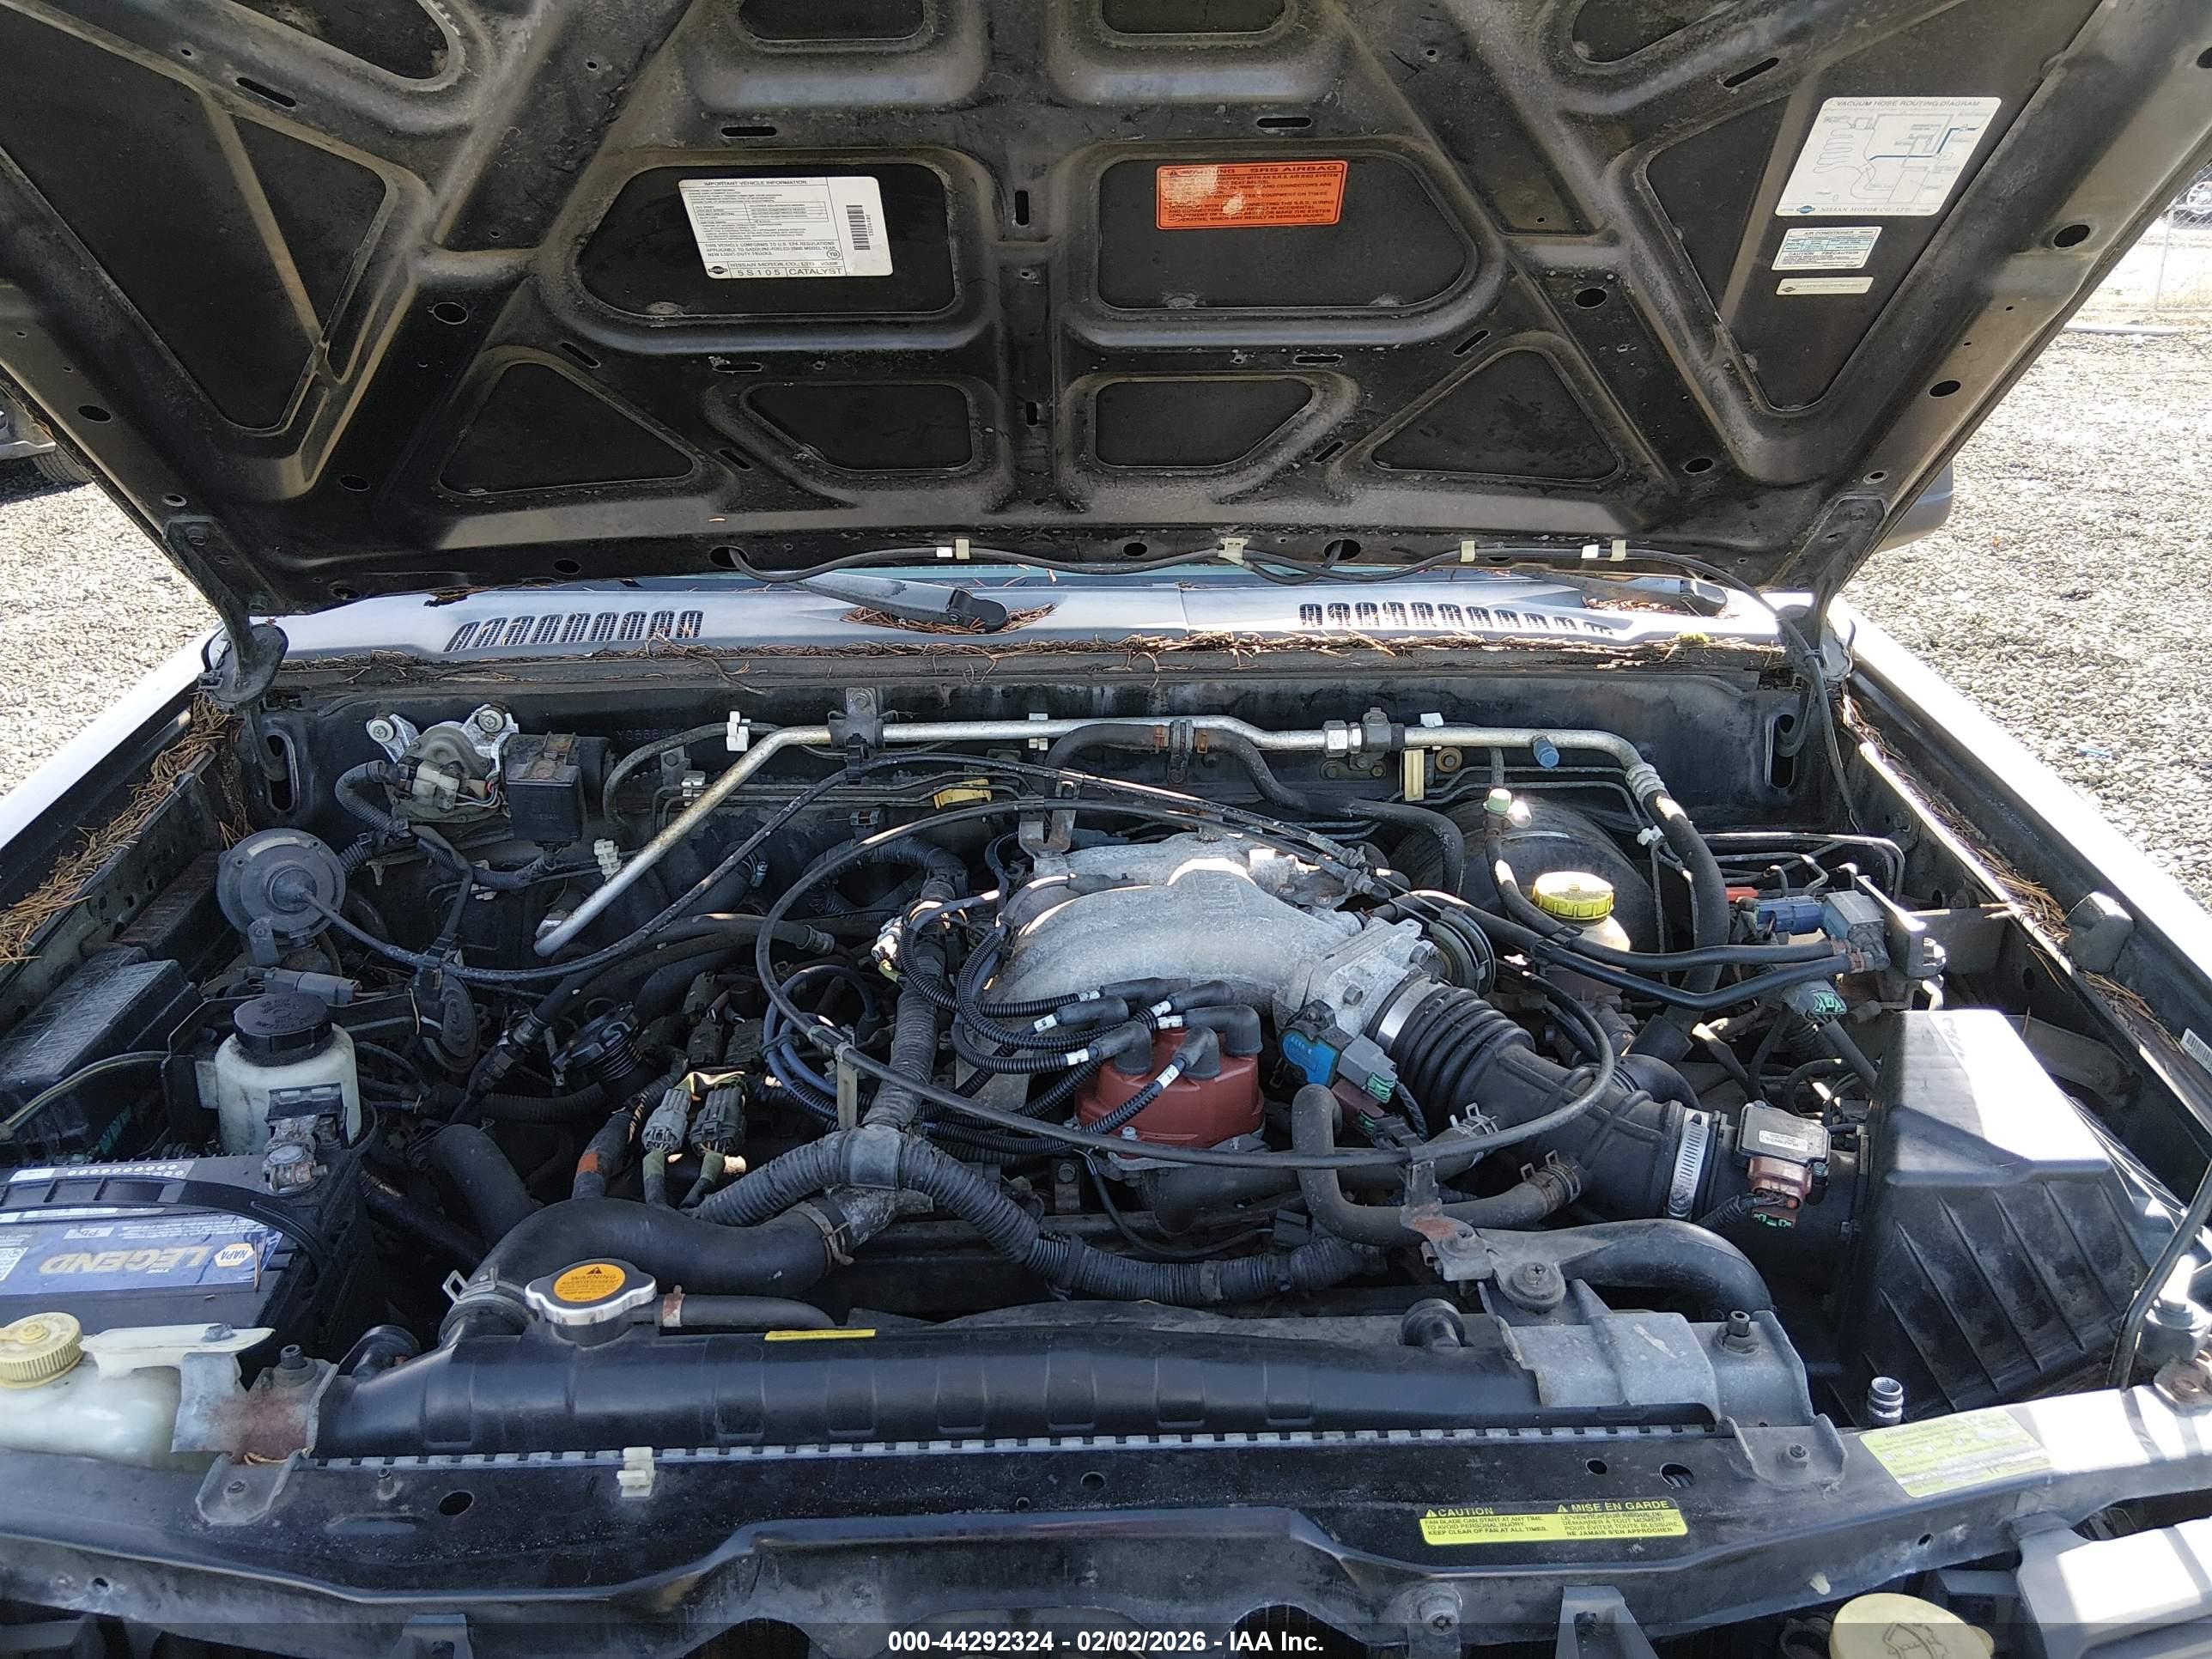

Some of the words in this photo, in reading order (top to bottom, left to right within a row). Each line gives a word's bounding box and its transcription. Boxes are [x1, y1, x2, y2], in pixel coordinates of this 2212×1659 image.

[40, 1246, 209, 1274] LEGEND
[216, 1249, 248, 1261] NAPA
[1436, 1506, 1494, 1517] CAUTION
[1572, 1504, 1601, 1512] MISE
[1606, 1501, 1622, 1510] EN
[1626, 1500, 1670, 1509] GARDE
